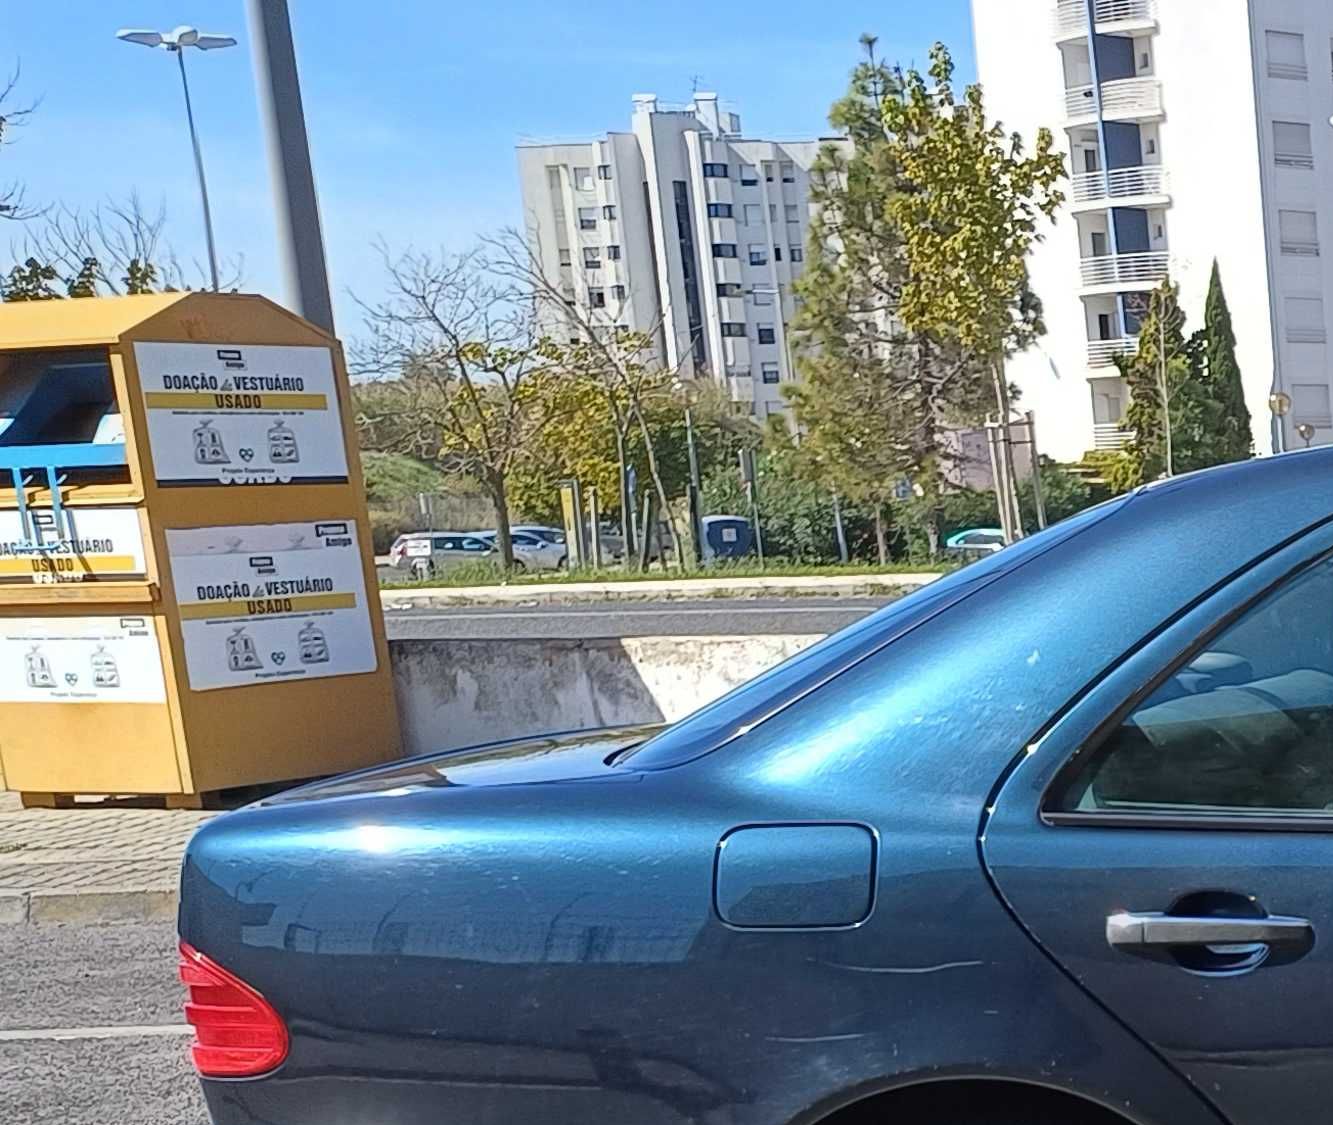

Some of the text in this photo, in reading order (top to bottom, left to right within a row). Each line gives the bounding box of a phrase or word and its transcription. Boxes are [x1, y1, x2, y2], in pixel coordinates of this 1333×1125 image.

[163, 372, 218, 393] DOAÇÃO
[232, 374, 305, 392] VESTUÁRIO
[214, 393, 262, 409] USADO
[31, 557, 74, 573] USADO
[196, 580, 250, 602] DOAÇÃO
[265, 575, 334, 596] VESTUÁRIO
[246, 597, 293, 616] USADO
